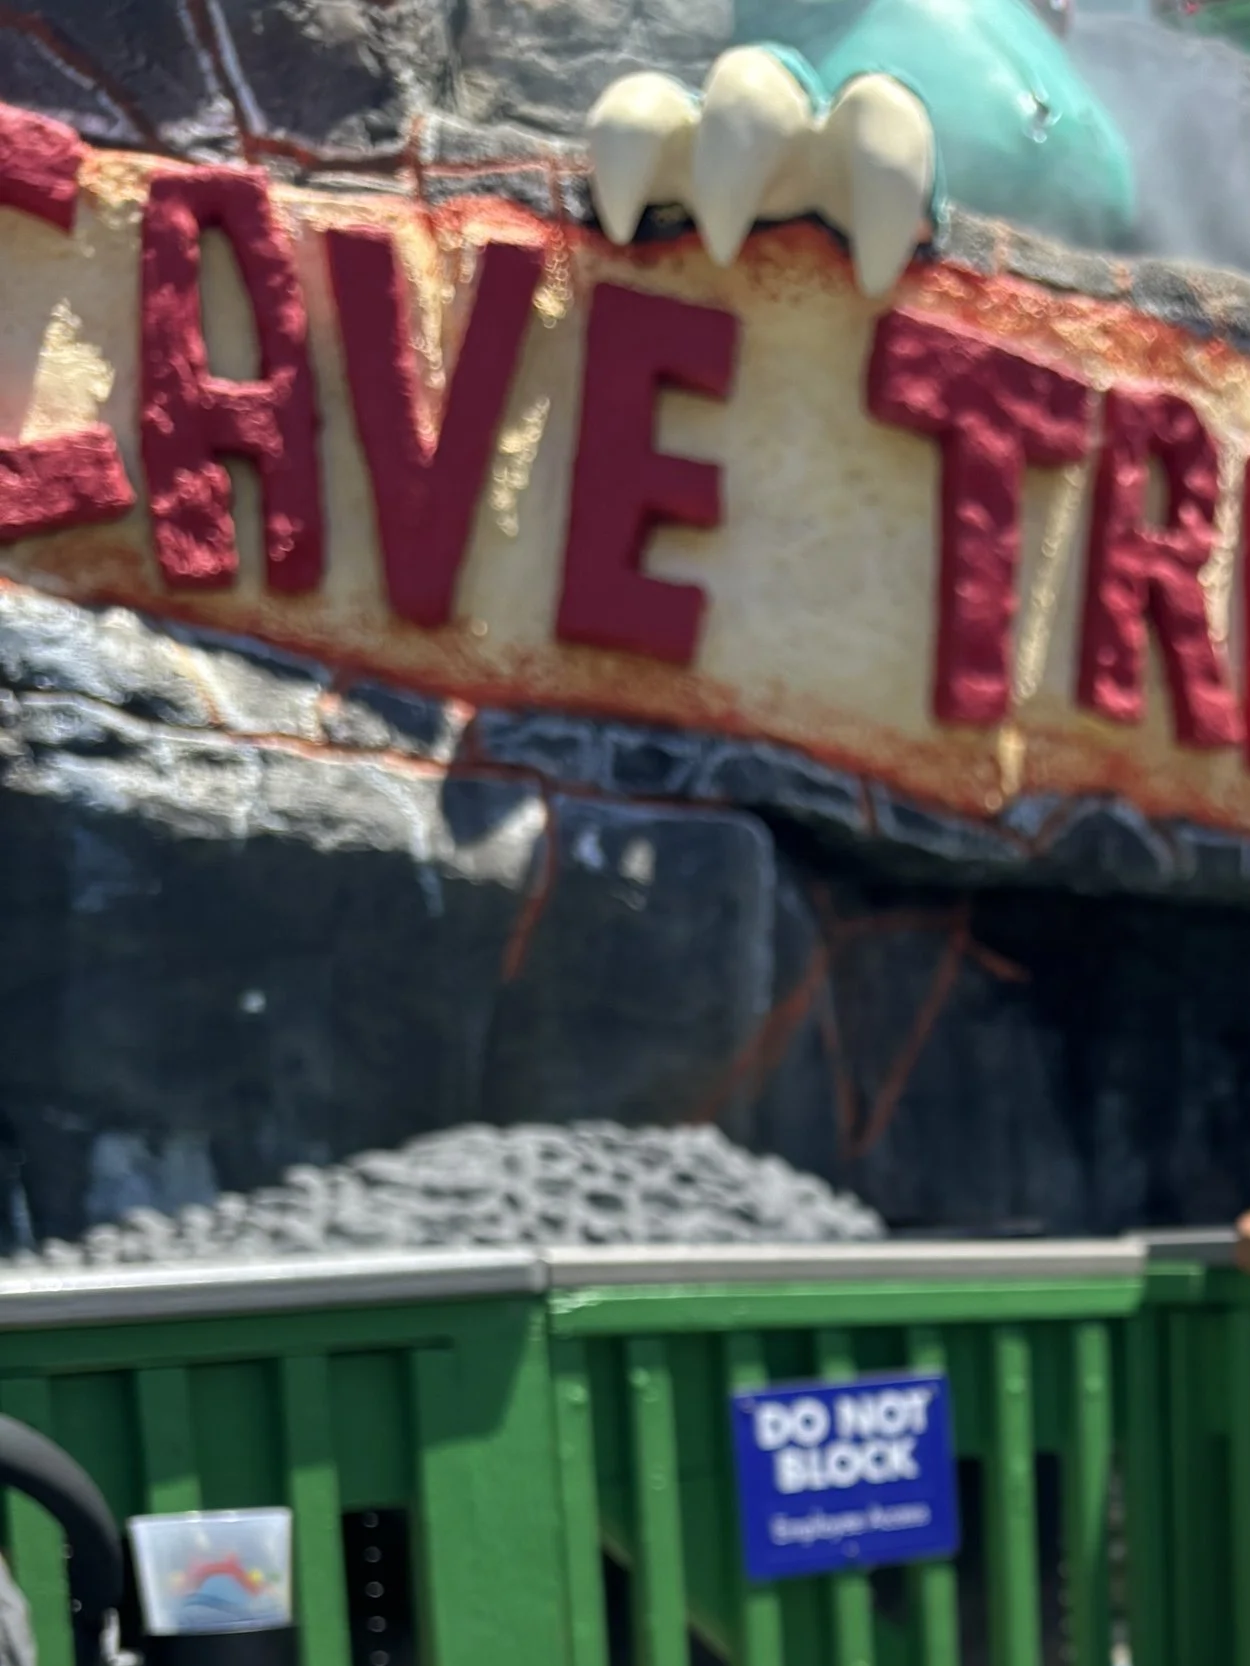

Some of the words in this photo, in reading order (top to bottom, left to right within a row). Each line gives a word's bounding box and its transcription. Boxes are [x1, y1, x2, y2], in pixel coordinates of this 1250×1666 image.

[756, 1397, 830, 1451] DO
[836, 1388, 932, 1437] NOT
[775, 1438, 920, 1493] BLOCK
